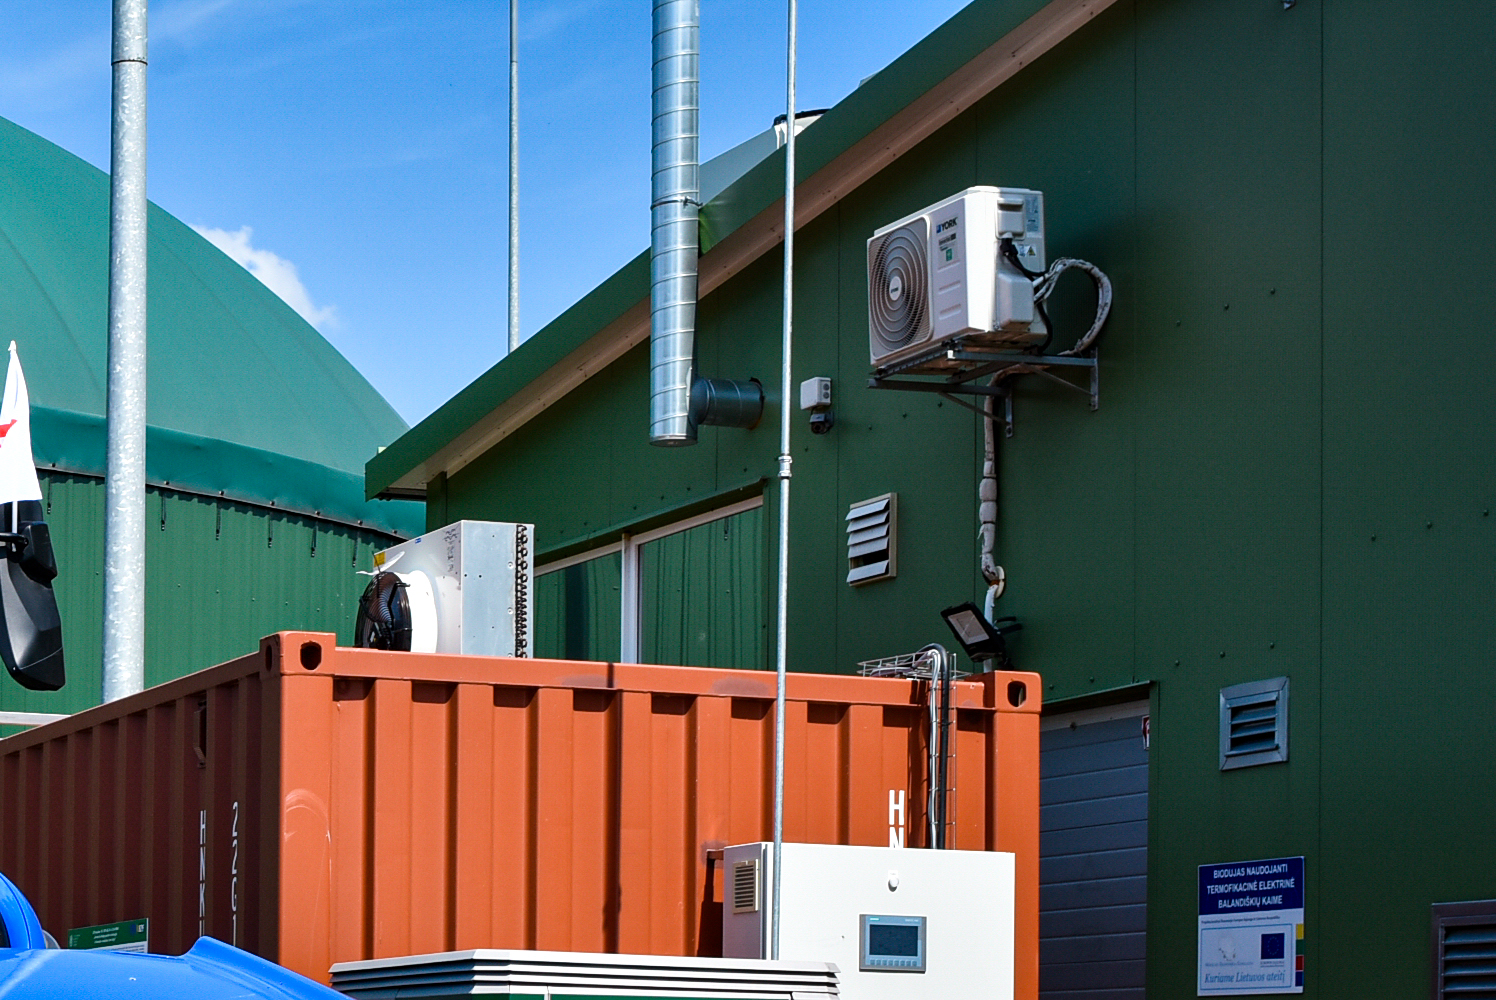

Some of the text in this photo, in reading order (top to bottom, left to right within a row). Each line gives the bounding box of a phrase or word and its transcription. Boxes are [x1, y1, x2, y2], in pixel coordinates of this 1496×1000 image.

[1213, 863, 1288, 879] BIODUJAS NAUDOJANTI
[1261, 895, 1283, 906] KAIME
